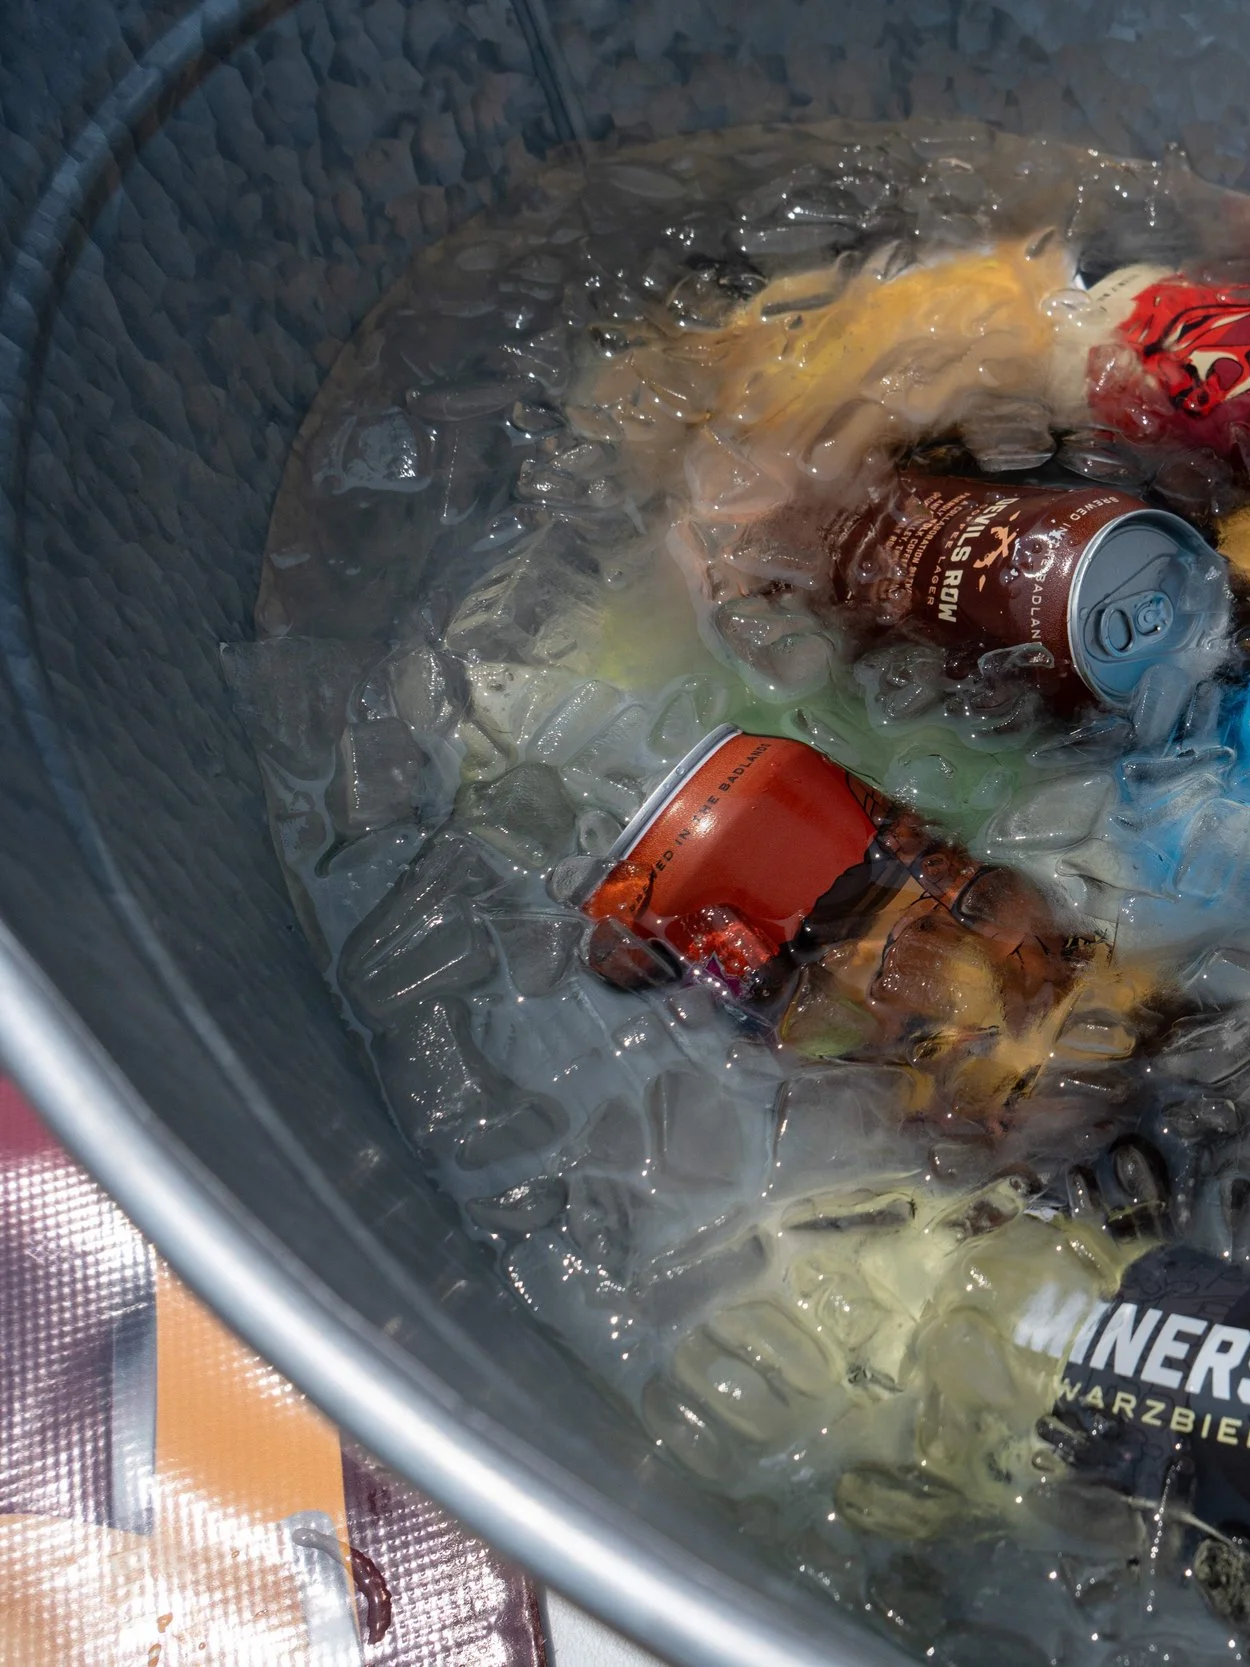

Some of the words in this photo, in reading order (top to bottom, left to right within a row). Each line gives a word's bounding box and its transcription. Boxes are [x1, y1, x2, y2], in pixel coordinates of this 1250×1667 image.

[911, 506, 963, 564] COLLABORATION
[950, 497, 1021, 563] DEVILS
[1069, 496, 1120, 521] BREWED
[926, 556, 947, 606] LAGER
[937, 569, 964, 623] ROW
[1029, 573, 1047, 645] BADLAN
[675, 827, 691, 846] IN
